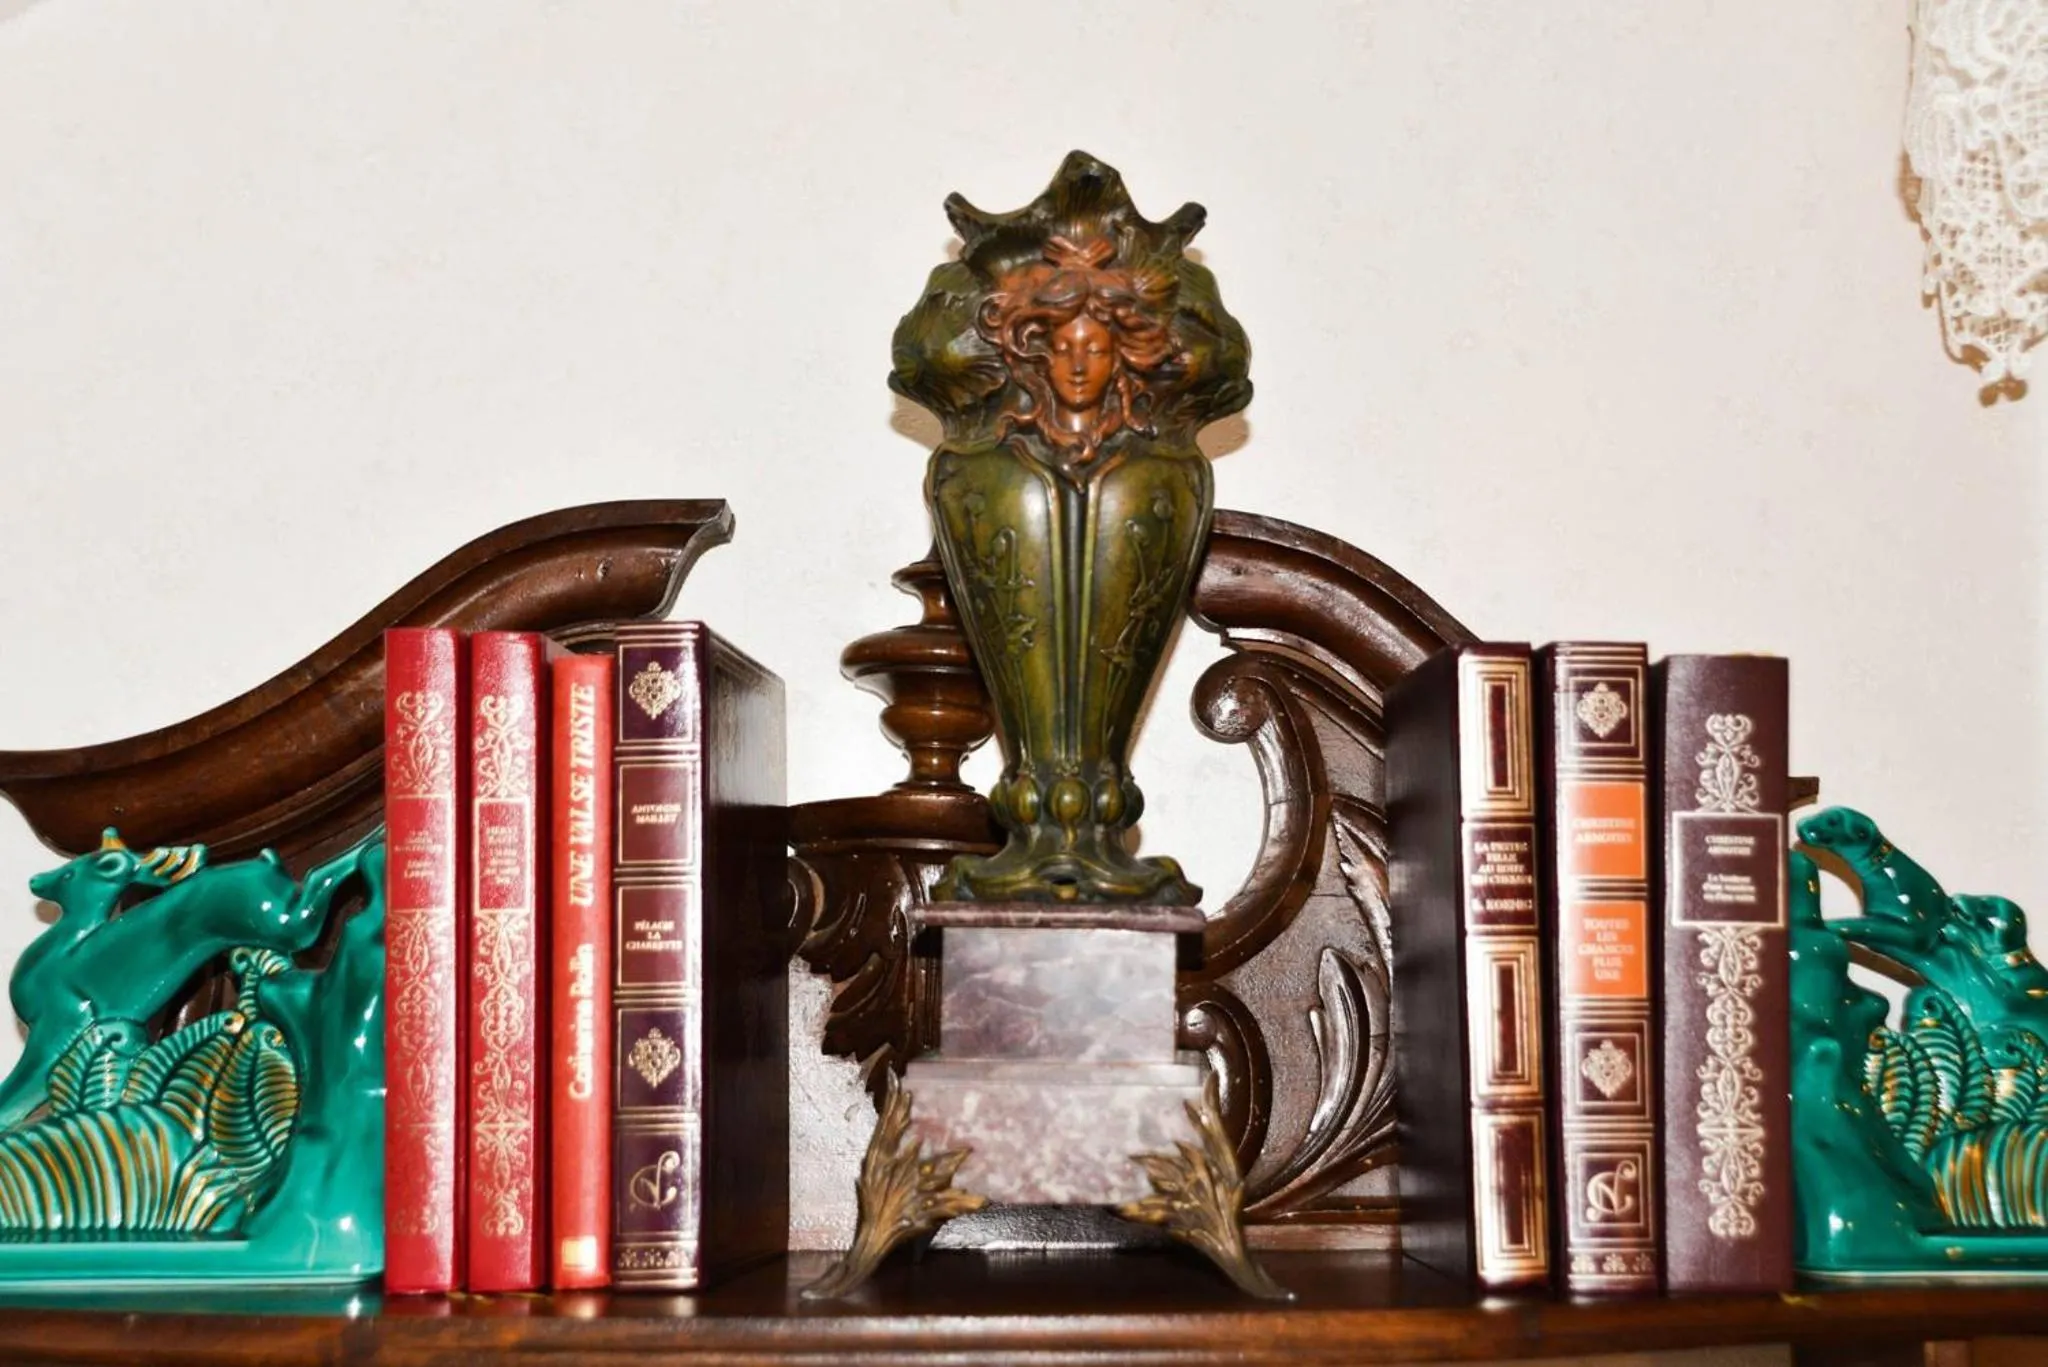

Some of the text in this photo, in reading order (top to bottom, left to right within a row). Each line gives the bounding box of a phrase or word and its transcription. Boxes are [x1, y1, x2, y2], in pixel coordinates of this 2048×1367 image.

[570, 683, 595, 907] UNE VALSE TRISTE
[647, 931, 662, 940] LA
[568, 1000, 593, 1098] Catherine
